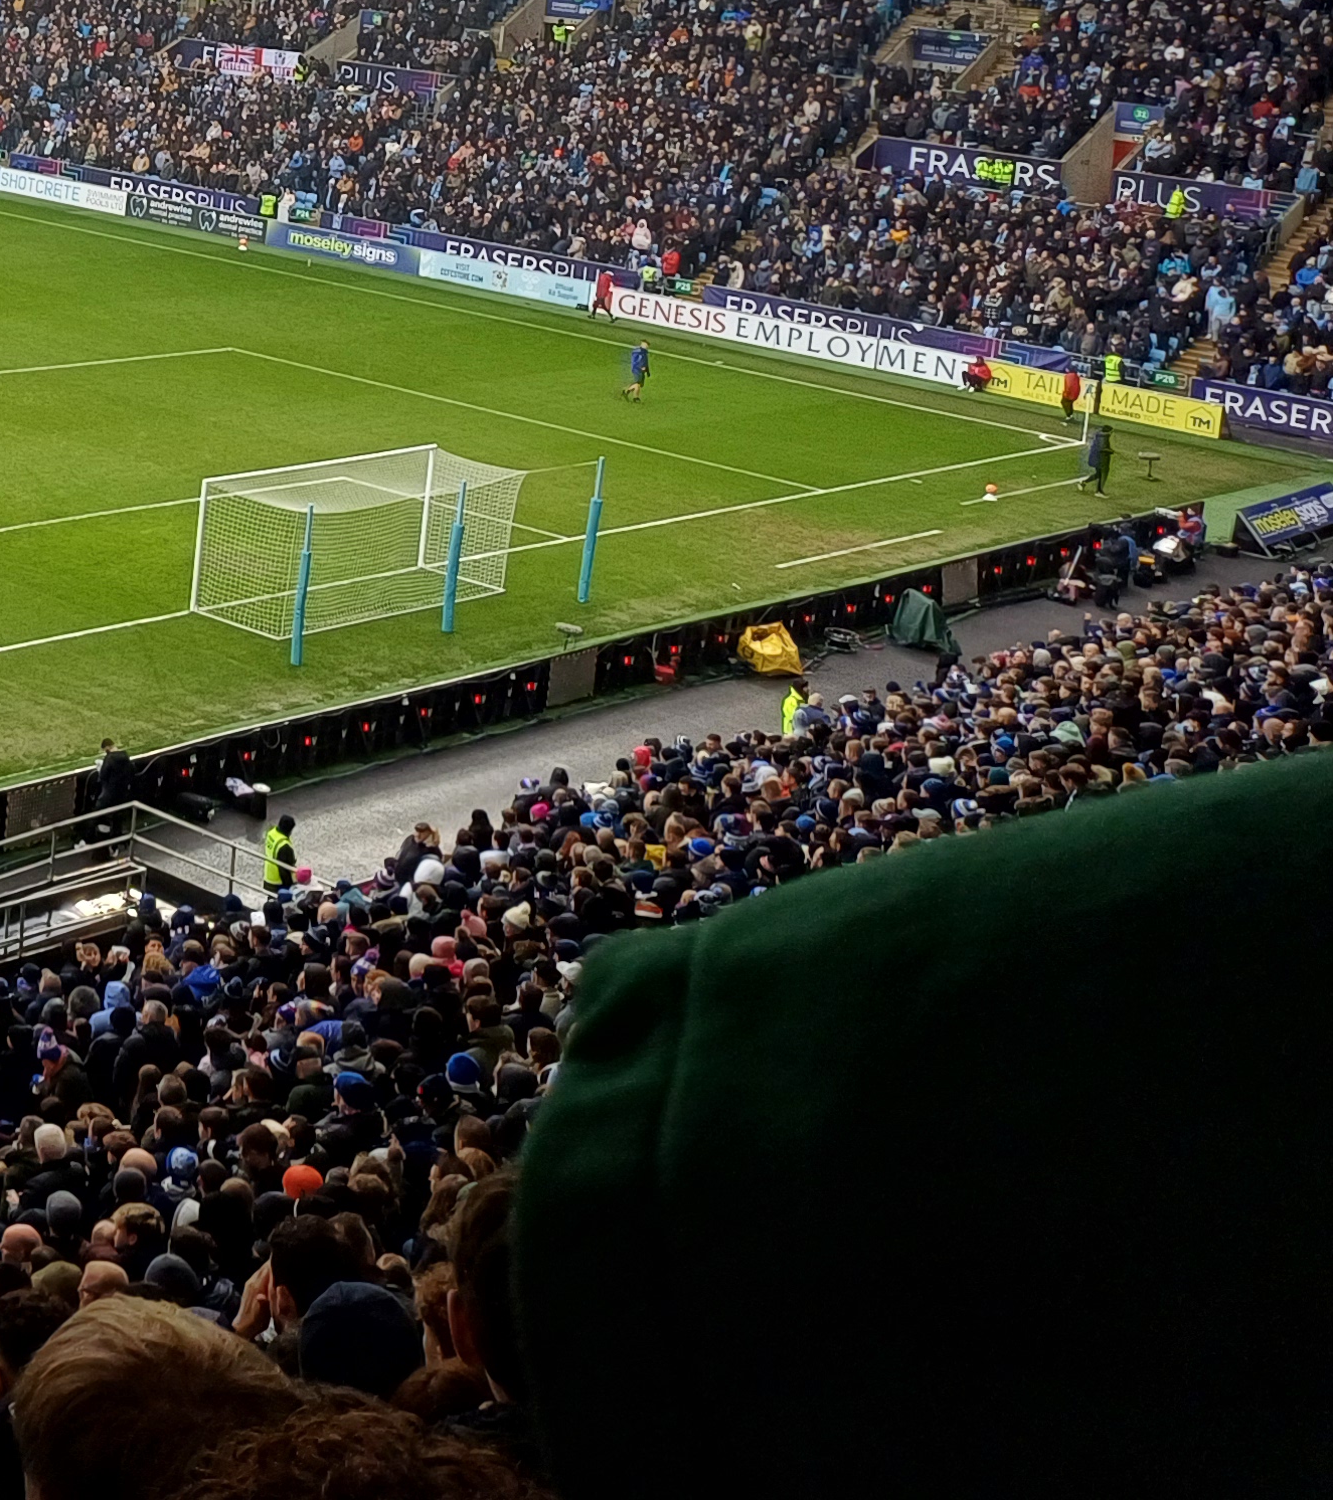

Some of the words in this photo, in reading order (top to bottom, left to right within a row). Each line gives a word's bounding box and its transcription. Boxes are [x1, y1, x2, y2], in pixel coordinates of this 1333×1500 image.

[909, 147, 1059, 190] FRARS
[0, 172, 82, 202] SHOTCRETE
[87, 188, 125, 201] SWIMMING
[110, 176, 247, 214] FRASERSPLUS
[85, 197, 109, 208] POOLS
[110, 201, 124, 211] LTD
[150, 200, 193, 215] andrewlee
[219, 213, 264, 229] andrewlee
[289, 231, 353, 256] moseley
[353, 244, 396, 263] signs
[618, 294, 726, 334] GENESIS
[725, 295, 913, 345] FRASERSPLUS
[991, 375, 1008, 390] TM
[1101, 405, 1141, 420] TAILORED
[1143, 414, 1156, 422] TO
[1157, 416, 1175, 427] YOU
[1111, 389, 1177, 418] MADE
[1205, 386, 1333, 435] FRASER
[1189, 415, 1211, 430] TM
[1252, 506, 1299, 533] moseley
